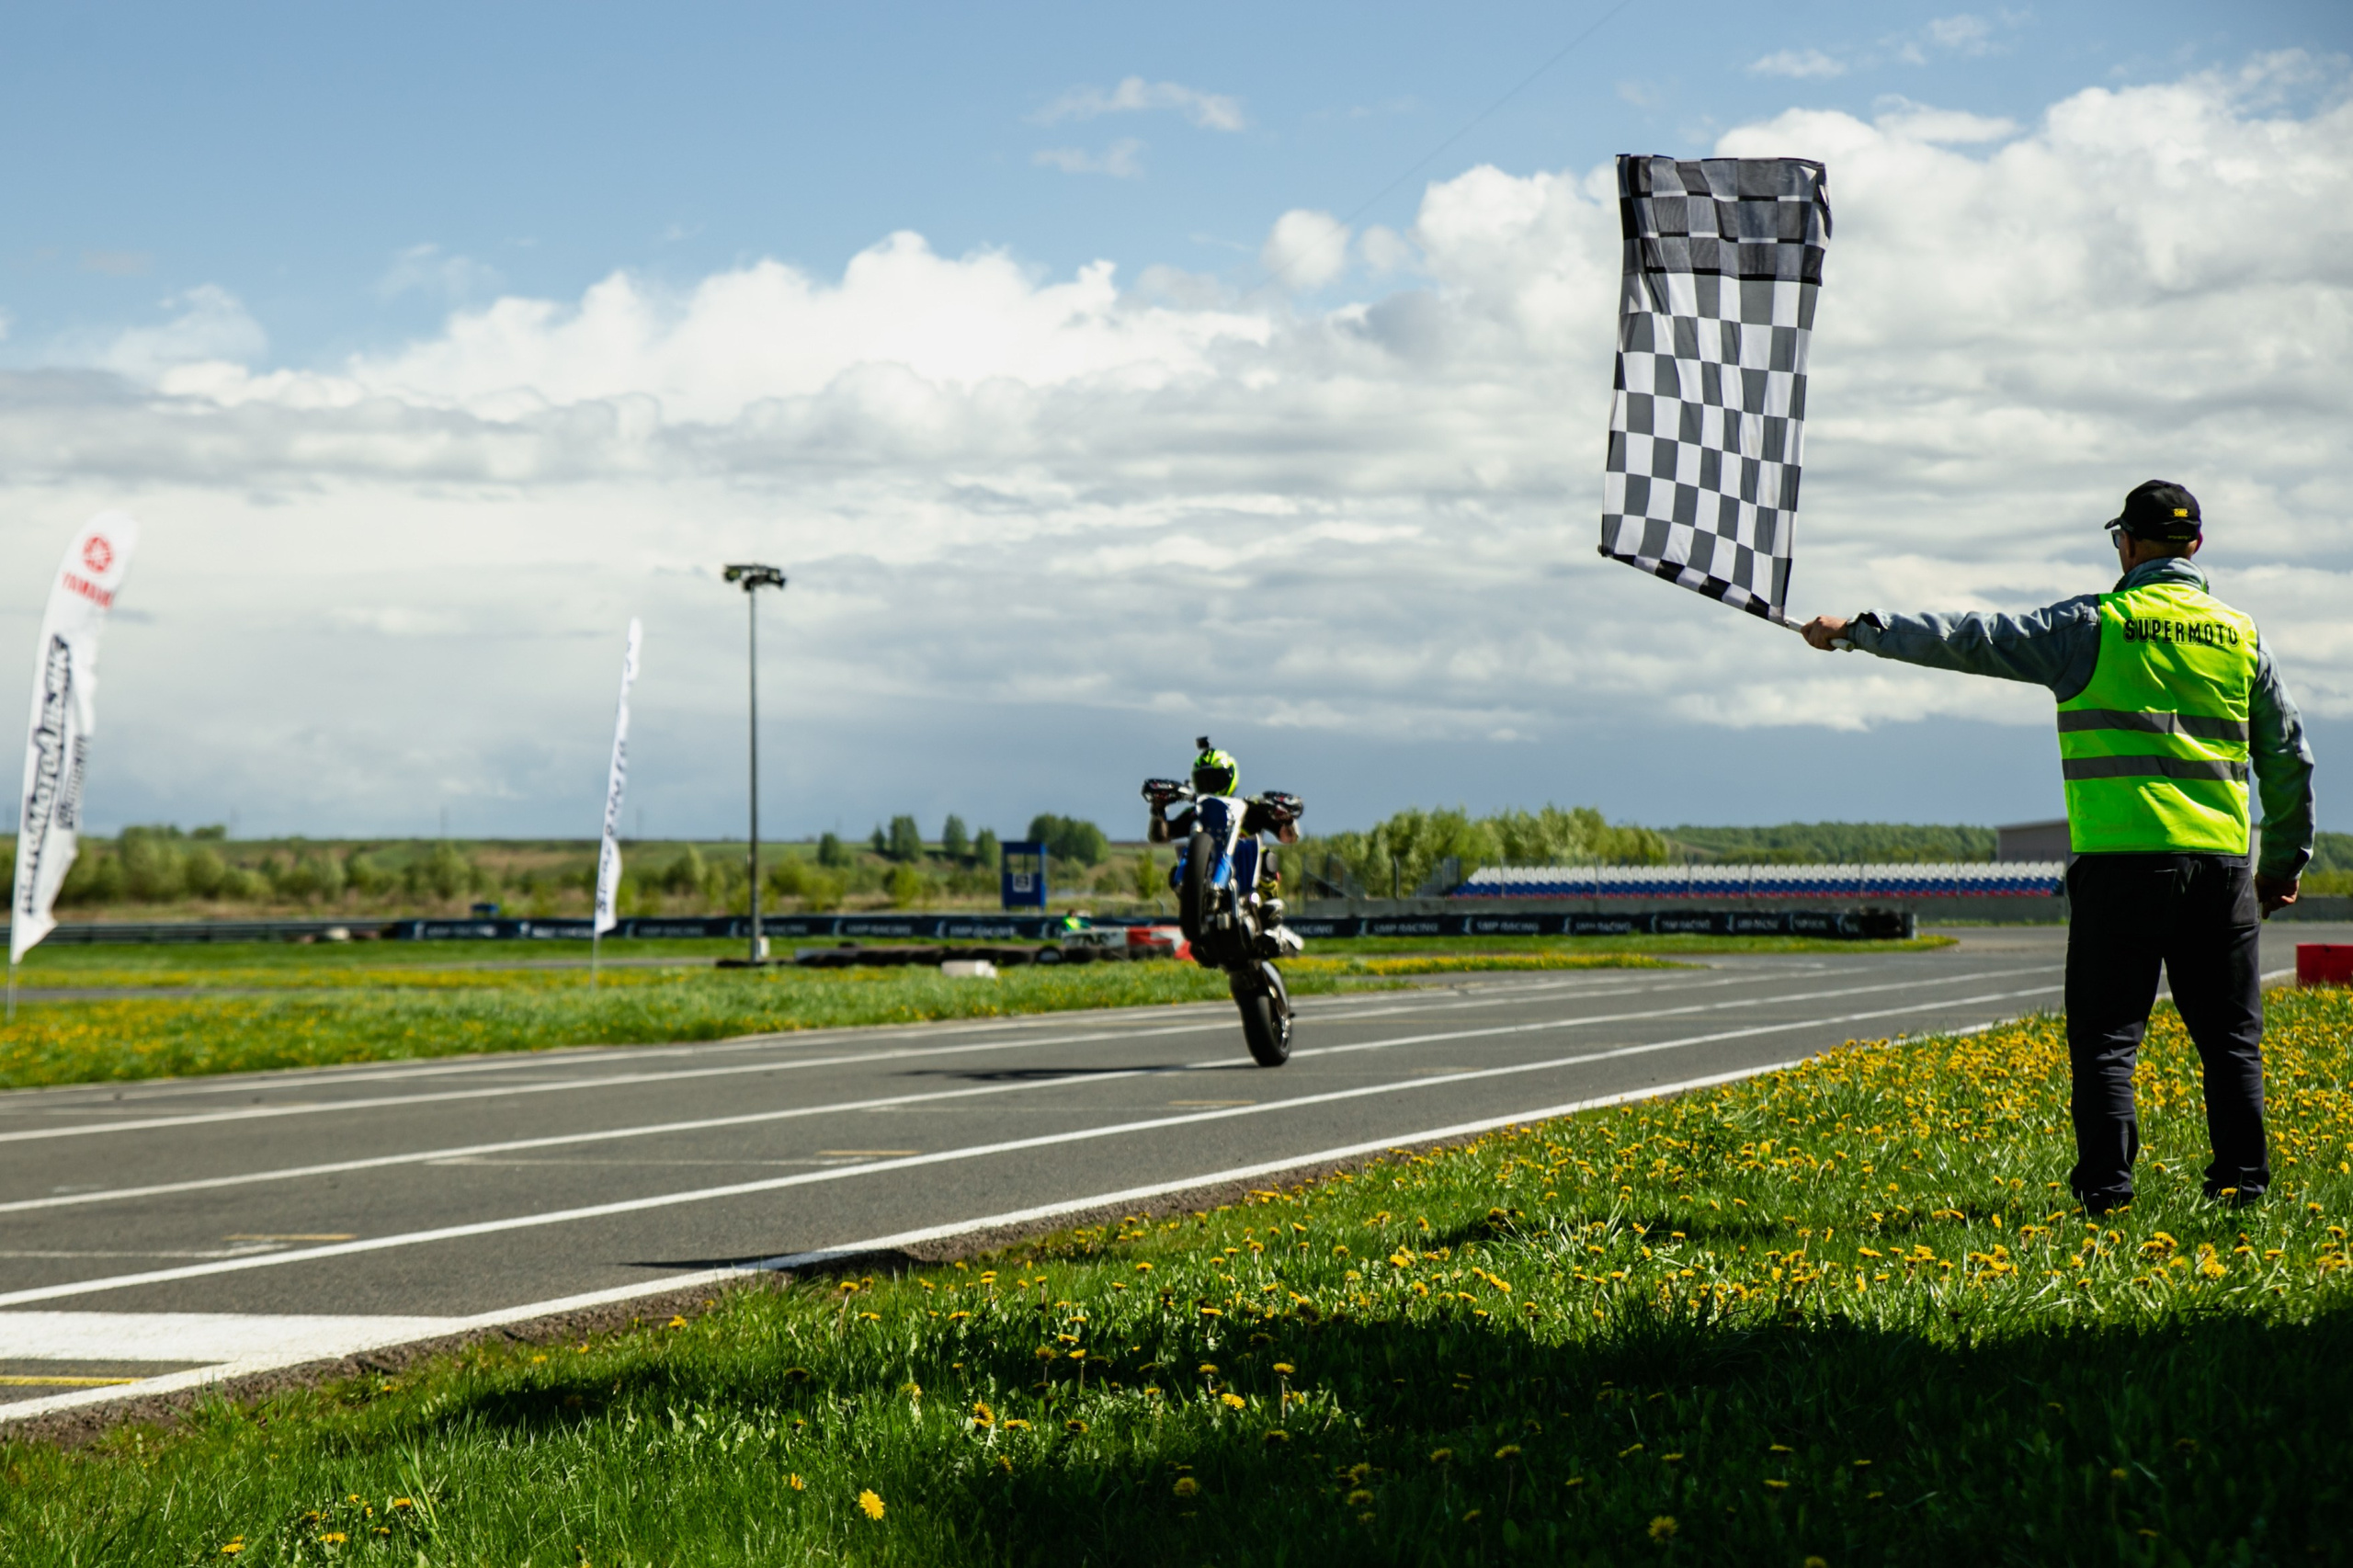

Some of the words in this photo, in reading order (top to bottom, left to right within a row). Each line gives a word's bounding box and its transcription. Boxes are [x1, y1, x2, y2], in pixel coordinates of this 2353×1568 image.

[2123, 617, 2240, 647] SUPERMOTO
[1373, 924, 1396, 933] SMP
[1476, 922, 1498, 931] SMP
[1499, 922, 1540, 931] RACING
